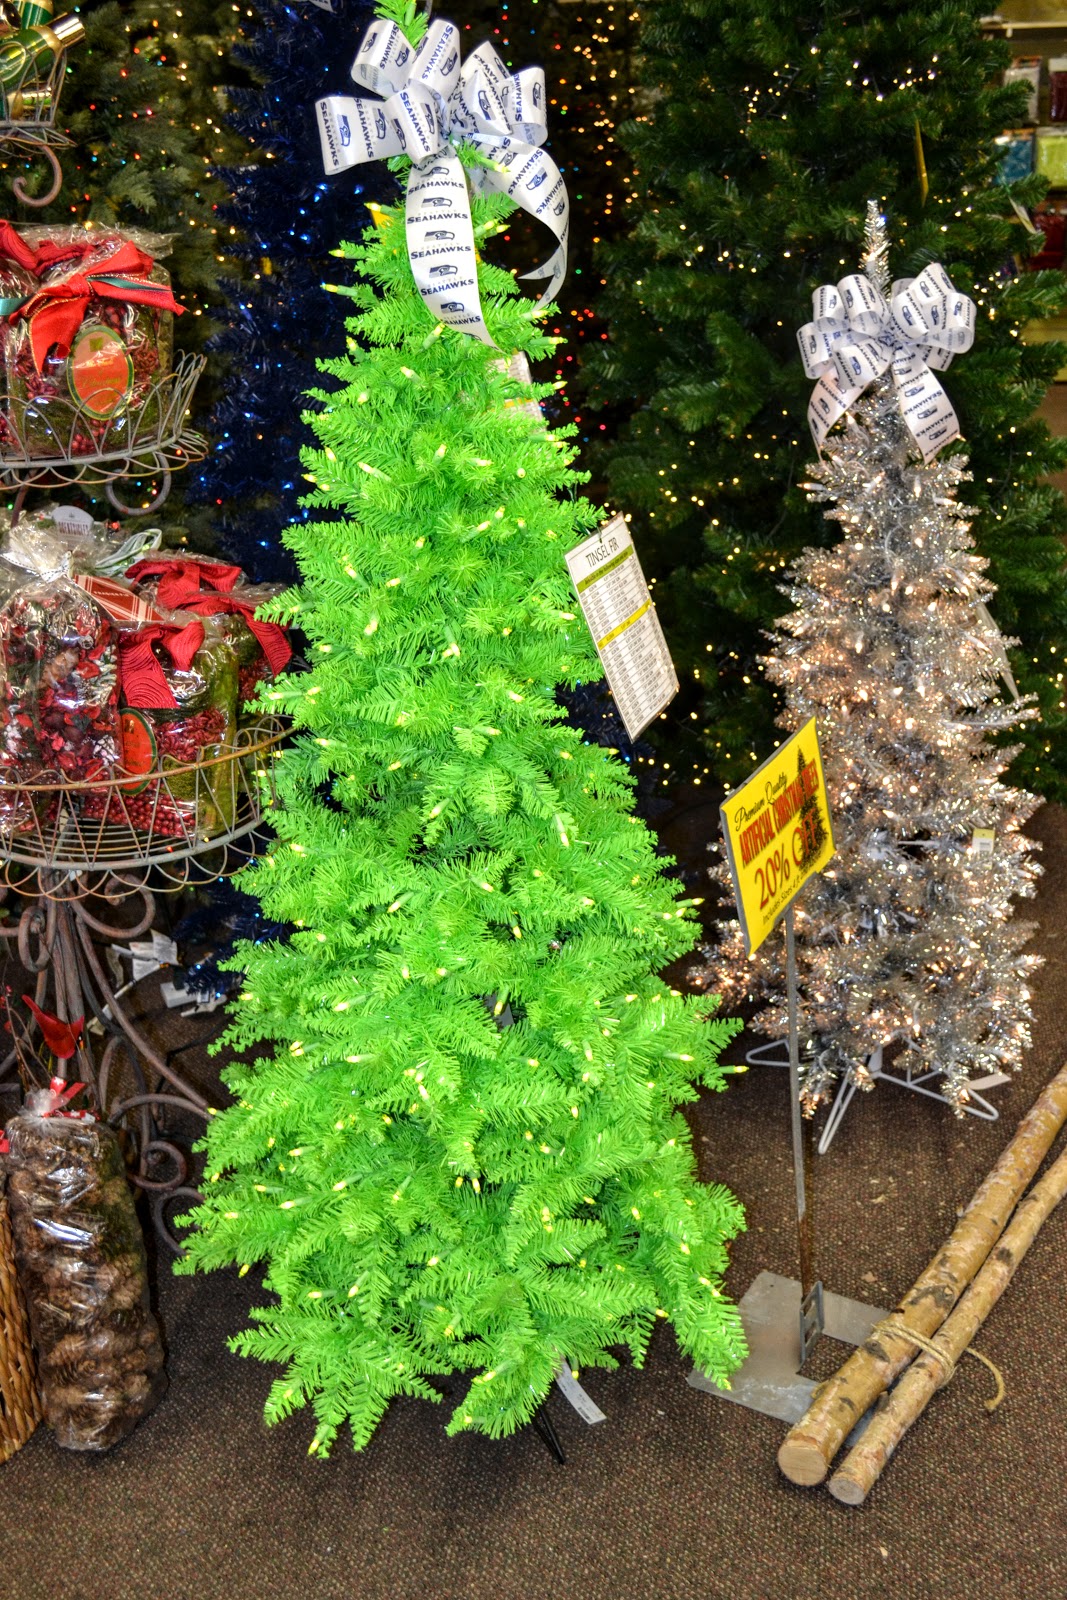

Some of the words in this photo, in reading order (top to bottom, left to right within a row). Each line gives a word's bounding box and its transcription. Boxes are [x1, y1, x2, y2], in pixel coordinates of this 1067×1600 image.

[379, 24, 400, 70] SEAHAWKS
[421, 25, 454, 80] SEAHAWKS
[320, 101, 339, 167] SEAHAWKS
[354, 97, 374, 158] SEAHAWKS
[400, 92, 431, 152] SEAHAWKS
[408, 181, 465, 195] SEAHAWKS
[508, 149, 544, 195] SEAHAWKS
[407, 213, 468, 224] SEAHAWKS
[411, 246, 471, 260] SEAHAWKS
[421, 278, 474, 297] SEAHAWKS
[904, 390, 943, 416] SEAHAWKS
[916, 411, 954, 437] SEAHAWKS
[585, 544, 611, 568] TINSEL
[608, 537, 620, 553] FIR
[734, 798, 766, 832] Premium
[765, 772, 788, 806] Quality
[739, 807, 776, 869] ARTIFICIAL
[754, 842, 790, 912] 20%
[791, 807, 818, 867] OFF
